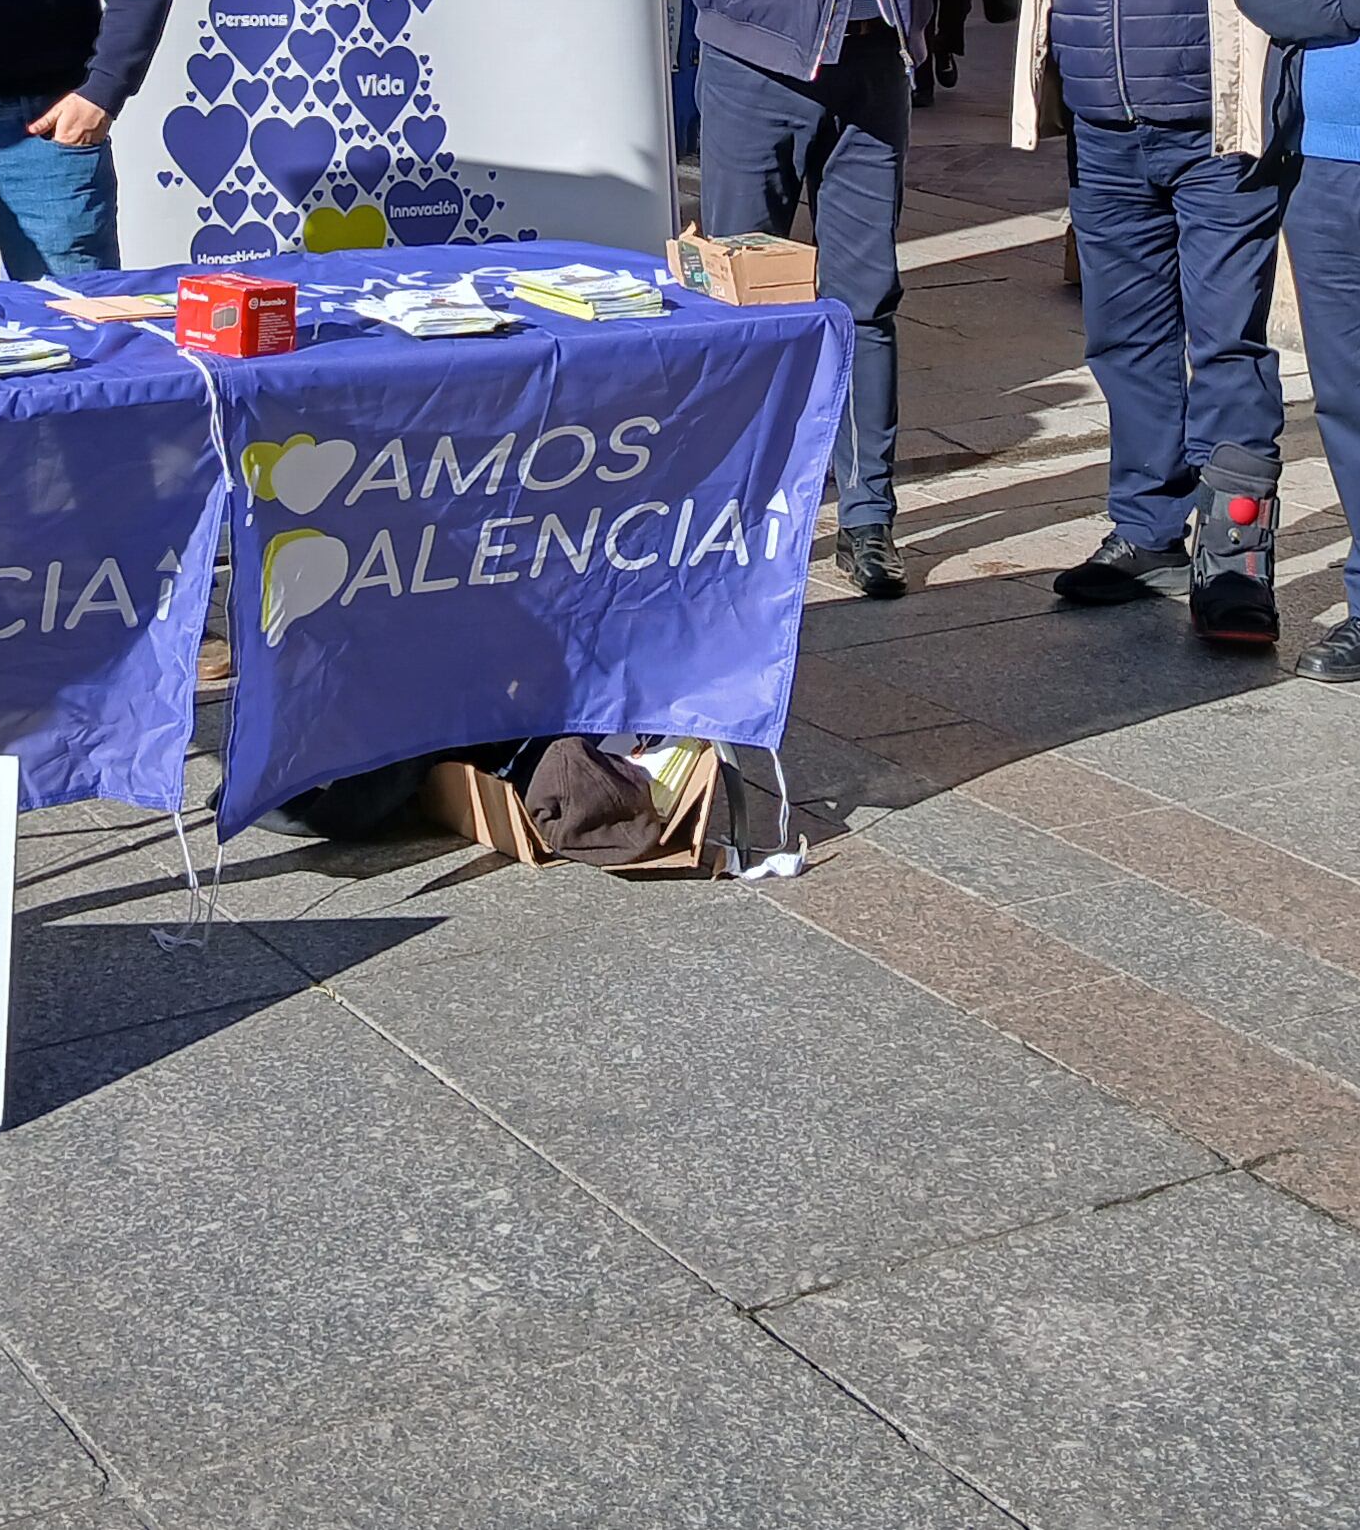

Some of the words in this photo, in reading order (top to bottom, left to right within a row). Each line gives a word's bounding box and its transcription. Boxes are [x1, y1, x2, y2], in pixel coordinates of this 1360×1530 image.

[215, 12, 288, 28] Personas
[357, 73, 405, 97] Vida
[390, 200, 459, 218] Innovación
